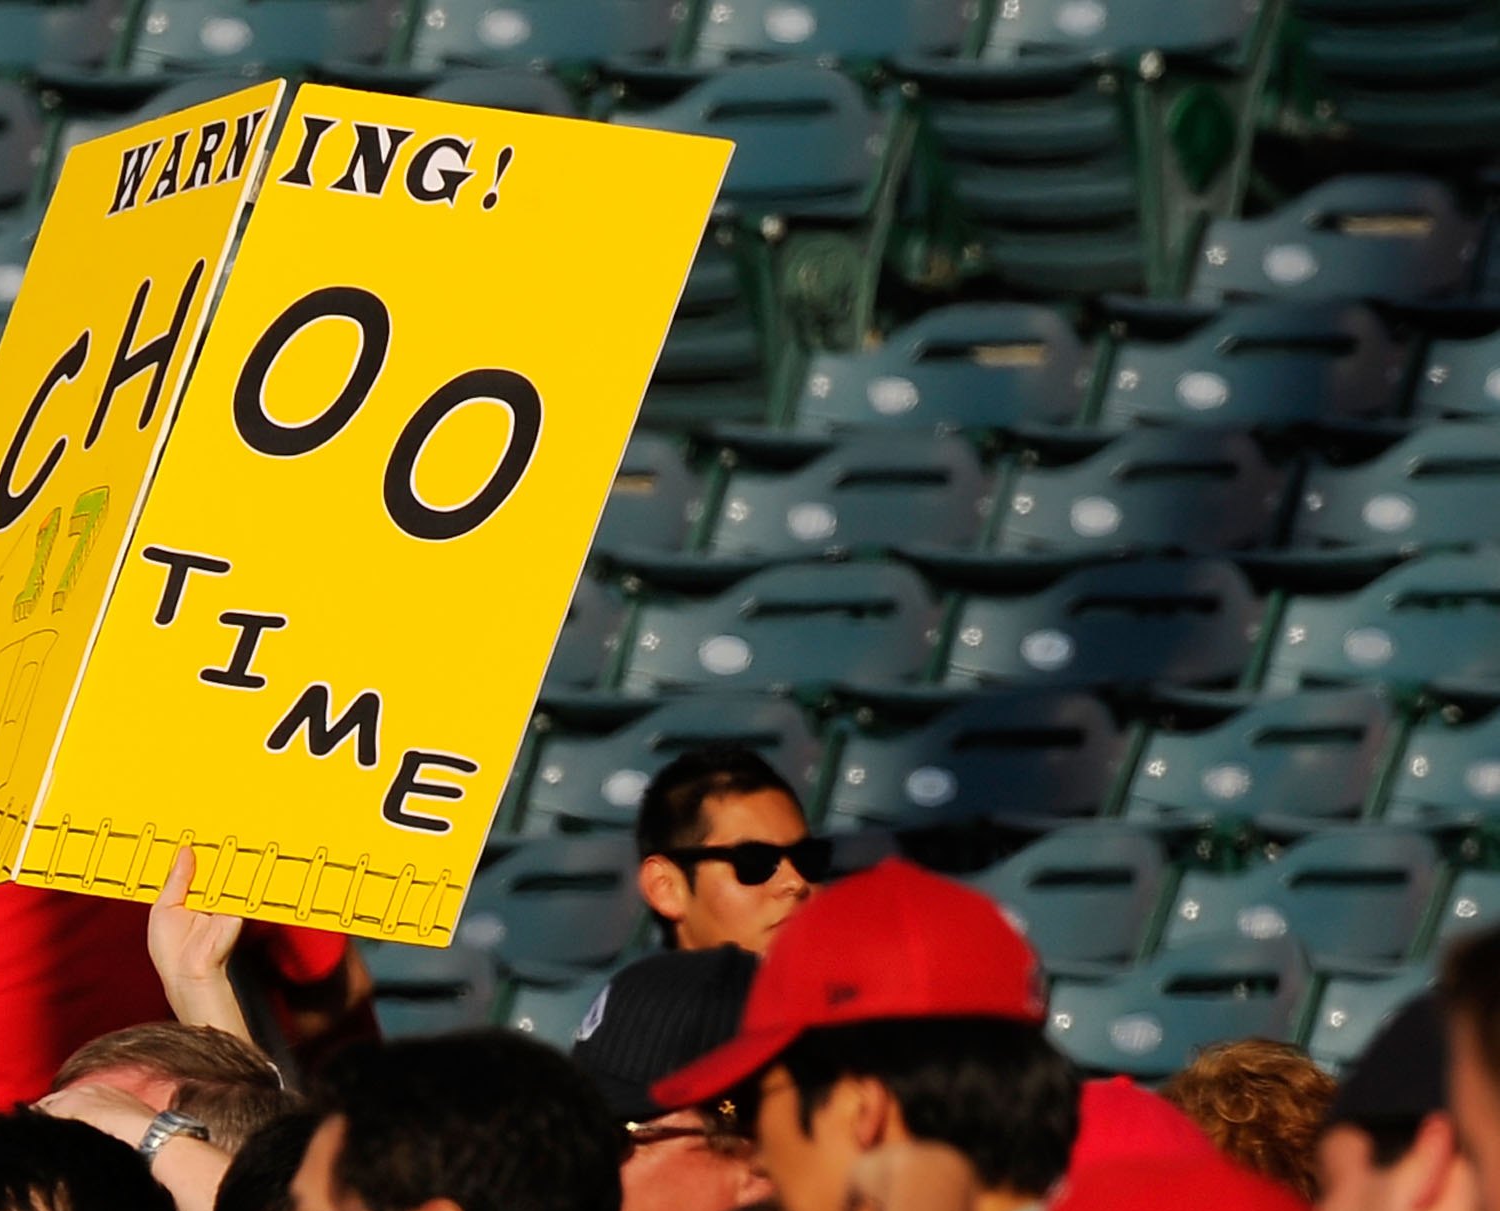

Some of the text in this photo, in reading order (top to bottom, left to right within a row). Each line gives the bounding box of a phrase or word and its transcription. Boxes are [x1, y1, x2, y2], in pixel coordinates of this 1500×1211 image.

[106, 108, 514, 216] WARNING!
[12, 486, 109, 622] 17
[142, 546, 478, 831] TIME
